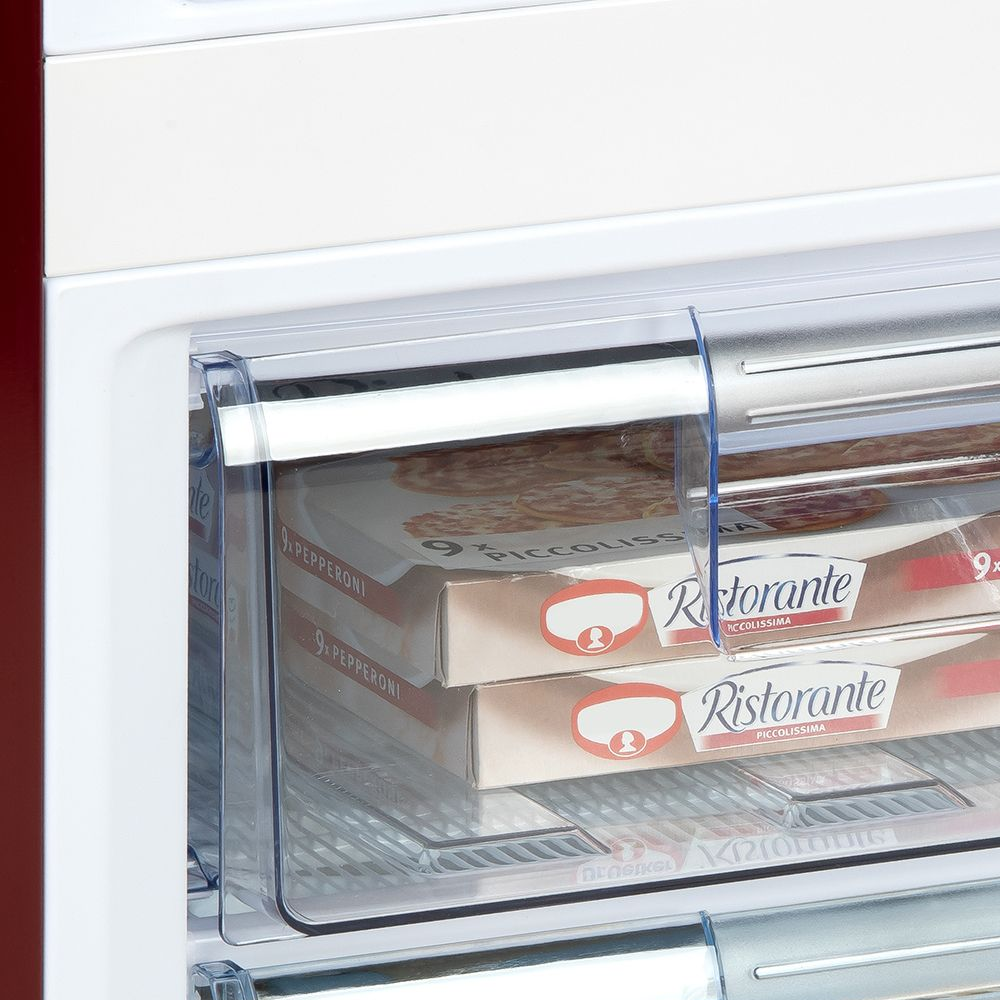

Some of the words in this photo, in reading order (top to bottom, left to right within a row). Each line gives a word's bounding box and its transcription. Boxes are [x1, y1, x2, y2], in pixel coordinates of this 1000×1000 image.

[295, 543, 366, 597] PEPPERONI
[332, 644, 401, 700] PEPPERONI
[697, 671, 887, 732] Ristorante
[756, 723, 826, 740] PICCOLISSIMA
